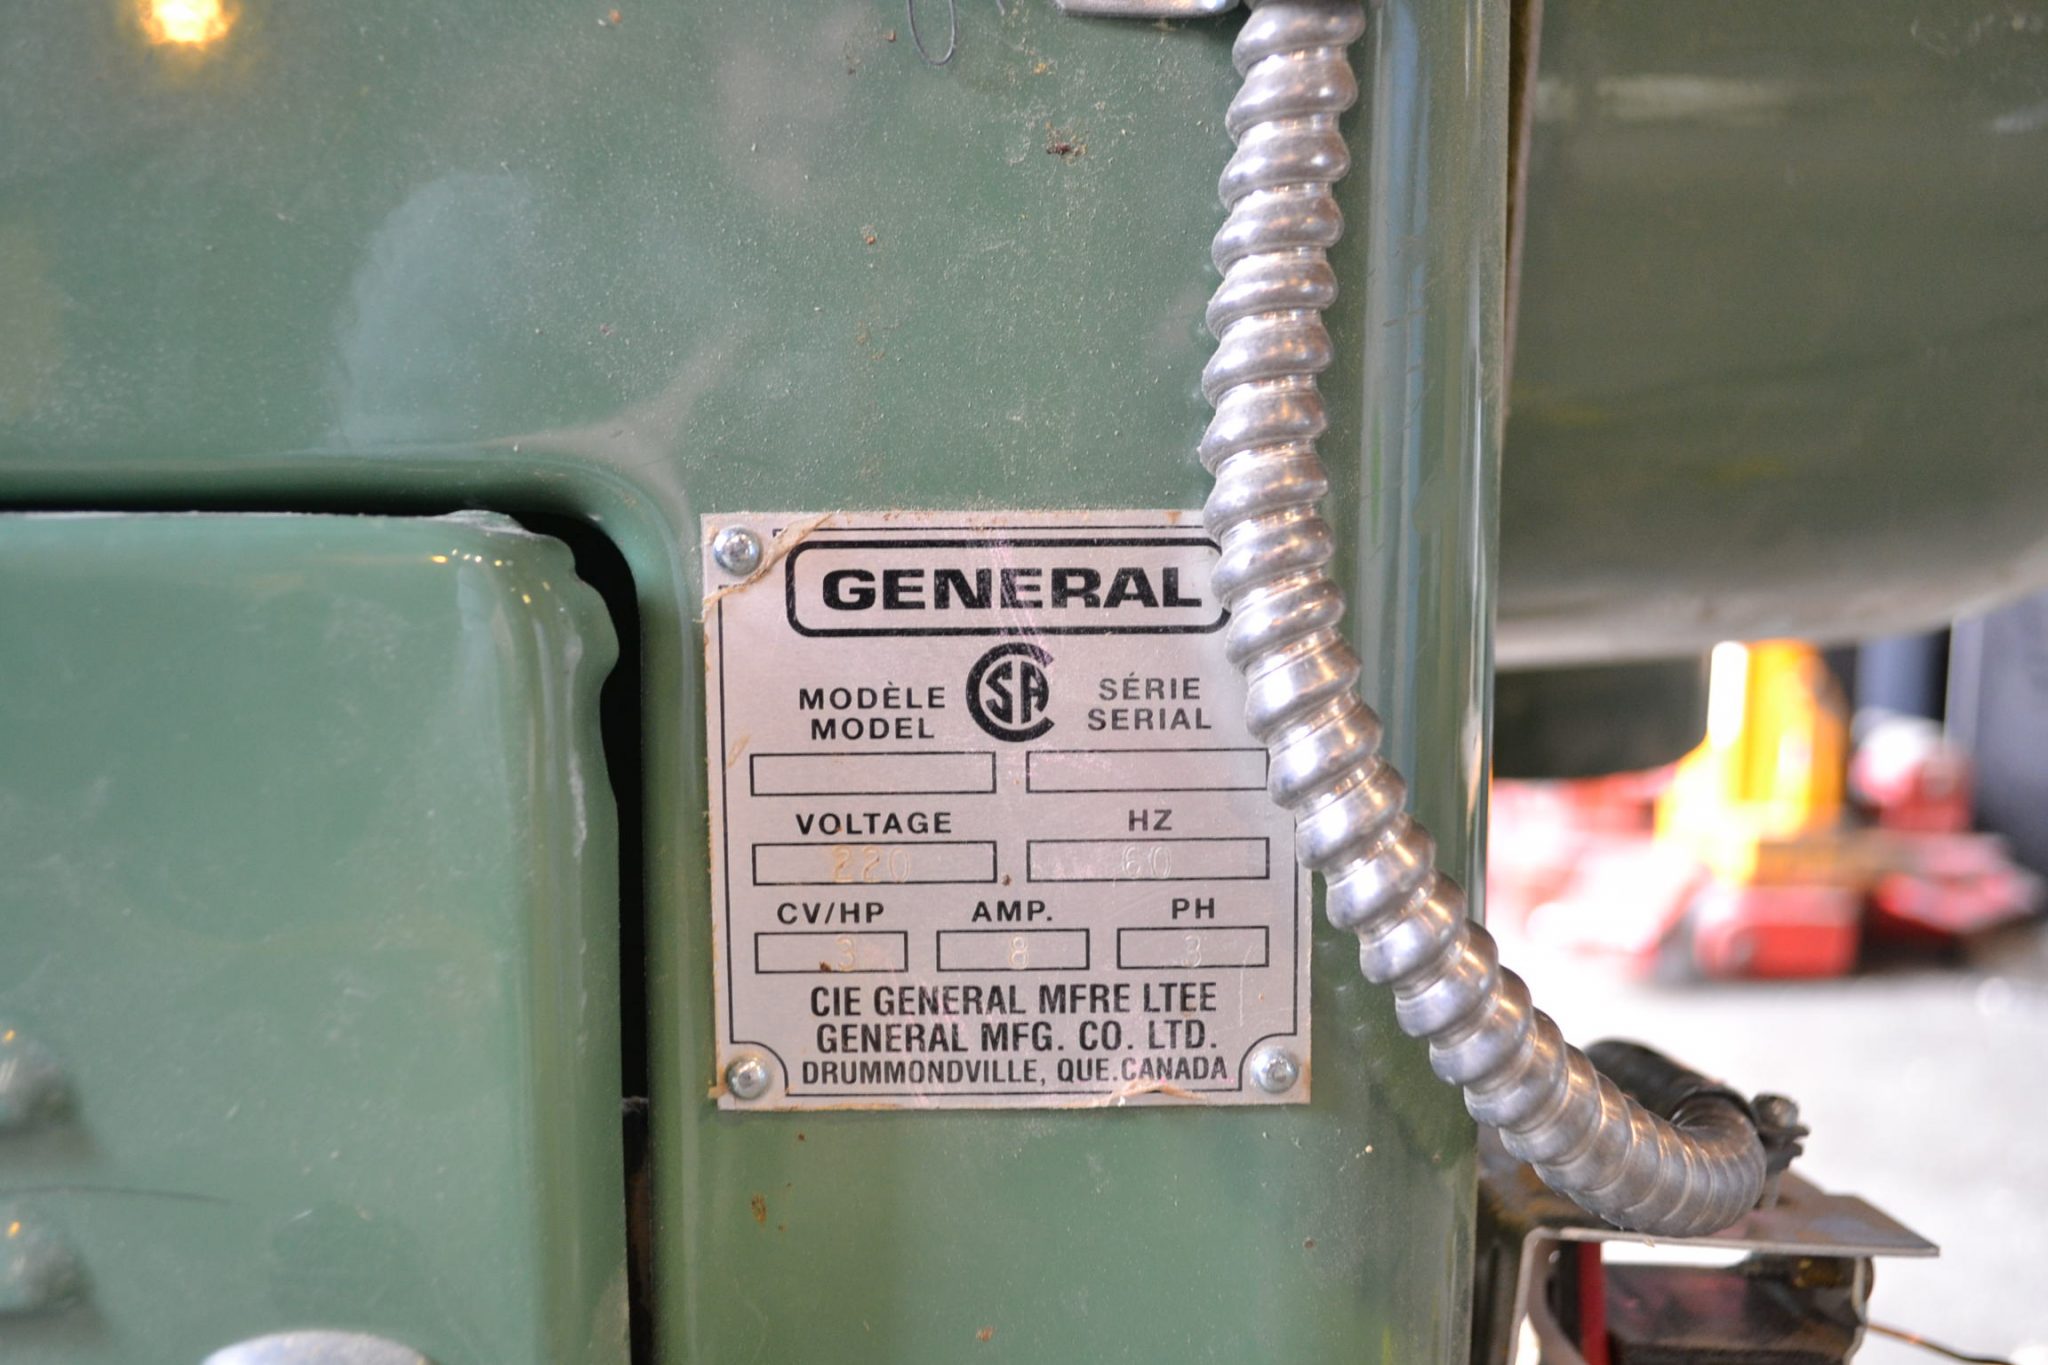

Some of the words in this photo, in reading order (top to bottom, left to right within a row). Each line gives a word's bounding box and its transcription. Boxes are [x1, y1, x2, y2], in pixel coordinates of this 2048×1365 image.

[822, 567, 1202, 611] GENERAL
[799, 681, 946, 710] MODÈLE
[1098, 671, 1201, 701] SÉRIE
[811, 717, 935, 740] MODEL
[1088, 707, 1212, 732] SERIAL
[796, 812, 952, 836] VOLTAGE
[1128, 809, 1173, 832] HZ
[831, 846, 910, 884] 220
[1120, 845, 1172, 878] 60
[777, 901, 885, 925] CV/HP
[972, 900, 1053, 923] AMP.
[1171, 897, 1216, 920] PH
[835, 936, 857, 972] 3
[1008, 935, 1031, 969] 8
[1182, 934, 1203, 967] 3
[810, 986, 862, 1018] CIE
[873, 984, 1026, 1016] GENERAL
[1038, 983, 1130, 1014] MFRE
[1143, 982, 1218, 1012] LTEE
[816, 1021, 968, 1053] GENERAL
[980, 1020, 1064, 1052] MFG.
[1078, 1020, 1134, 1050] CO.
[1148, 1018, 1218, 1048] LTD.
[802, 1060, 1046, 1086] DRUMMONDVILLE,
